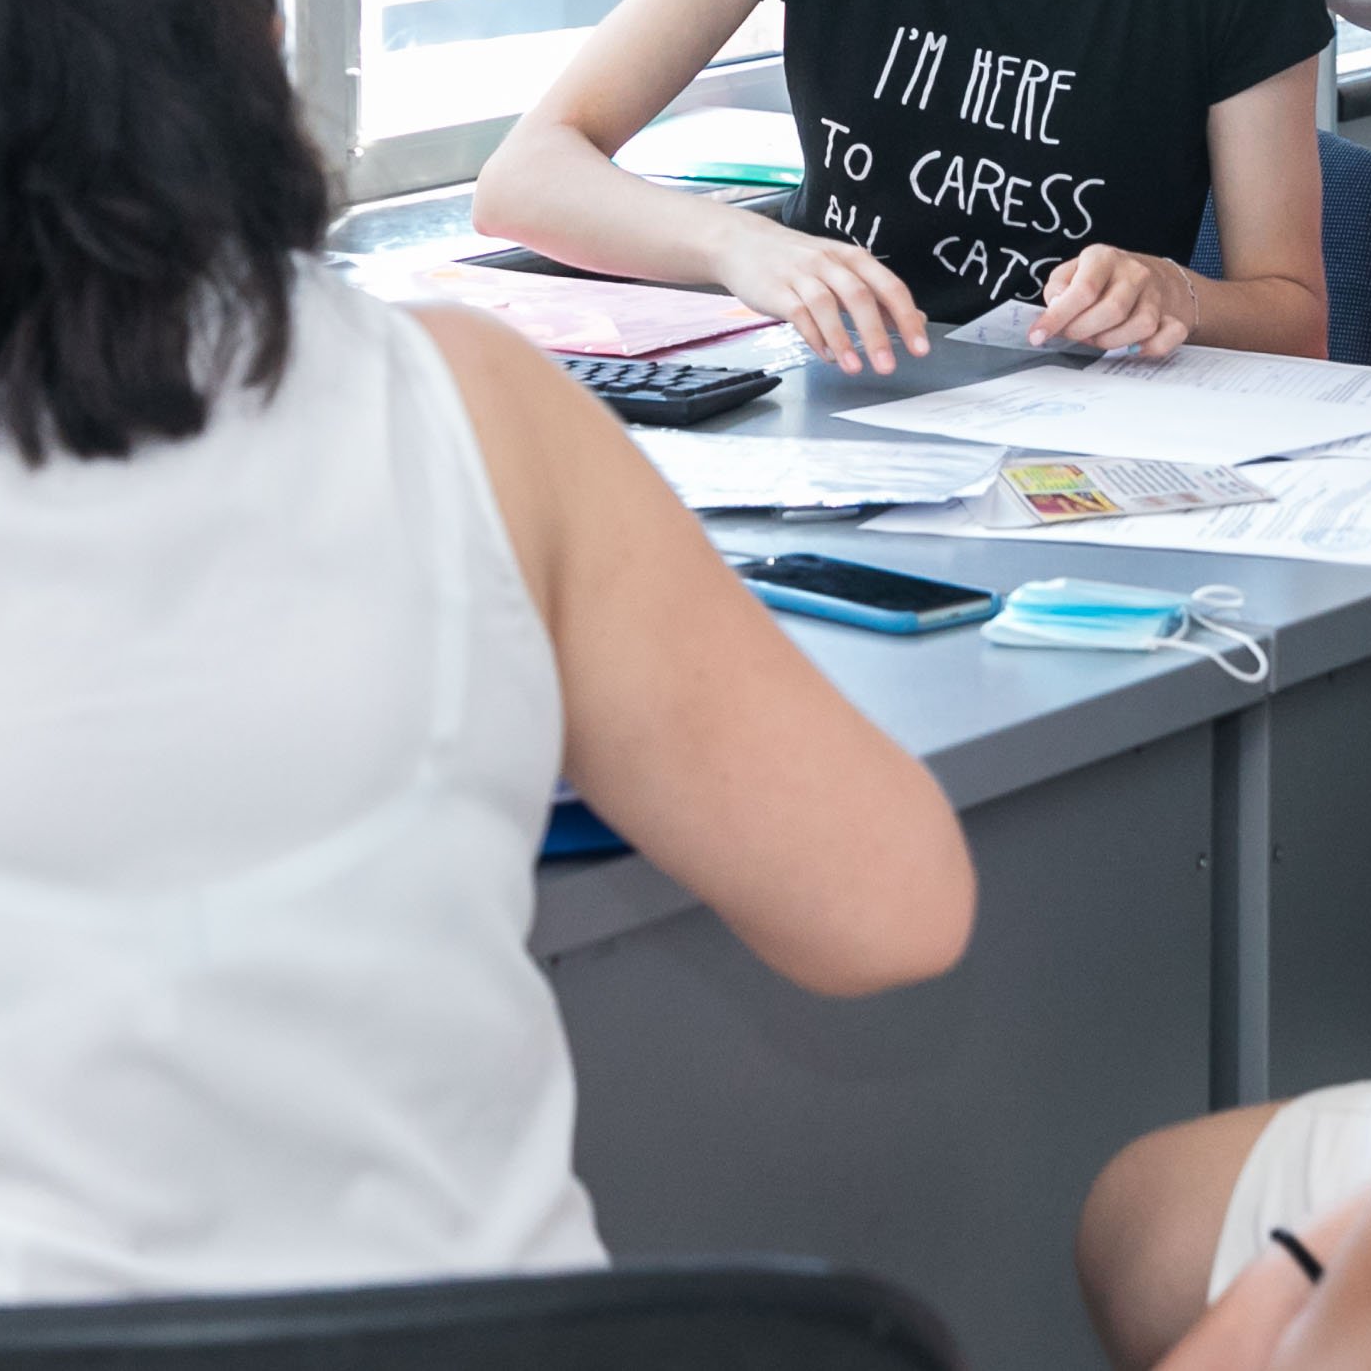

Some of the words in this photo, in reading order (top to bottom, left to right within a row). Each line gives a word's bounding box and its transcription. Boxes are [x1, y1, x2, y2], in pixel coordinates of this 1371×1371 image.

[873, 26, 948, 110] I'M
[960, 48, 1077, 145] HERE
[820, 117, 873, 181] TO
[909, 150, 1105, 240] CARESS
[933, 235, 1064, 302] CATS
